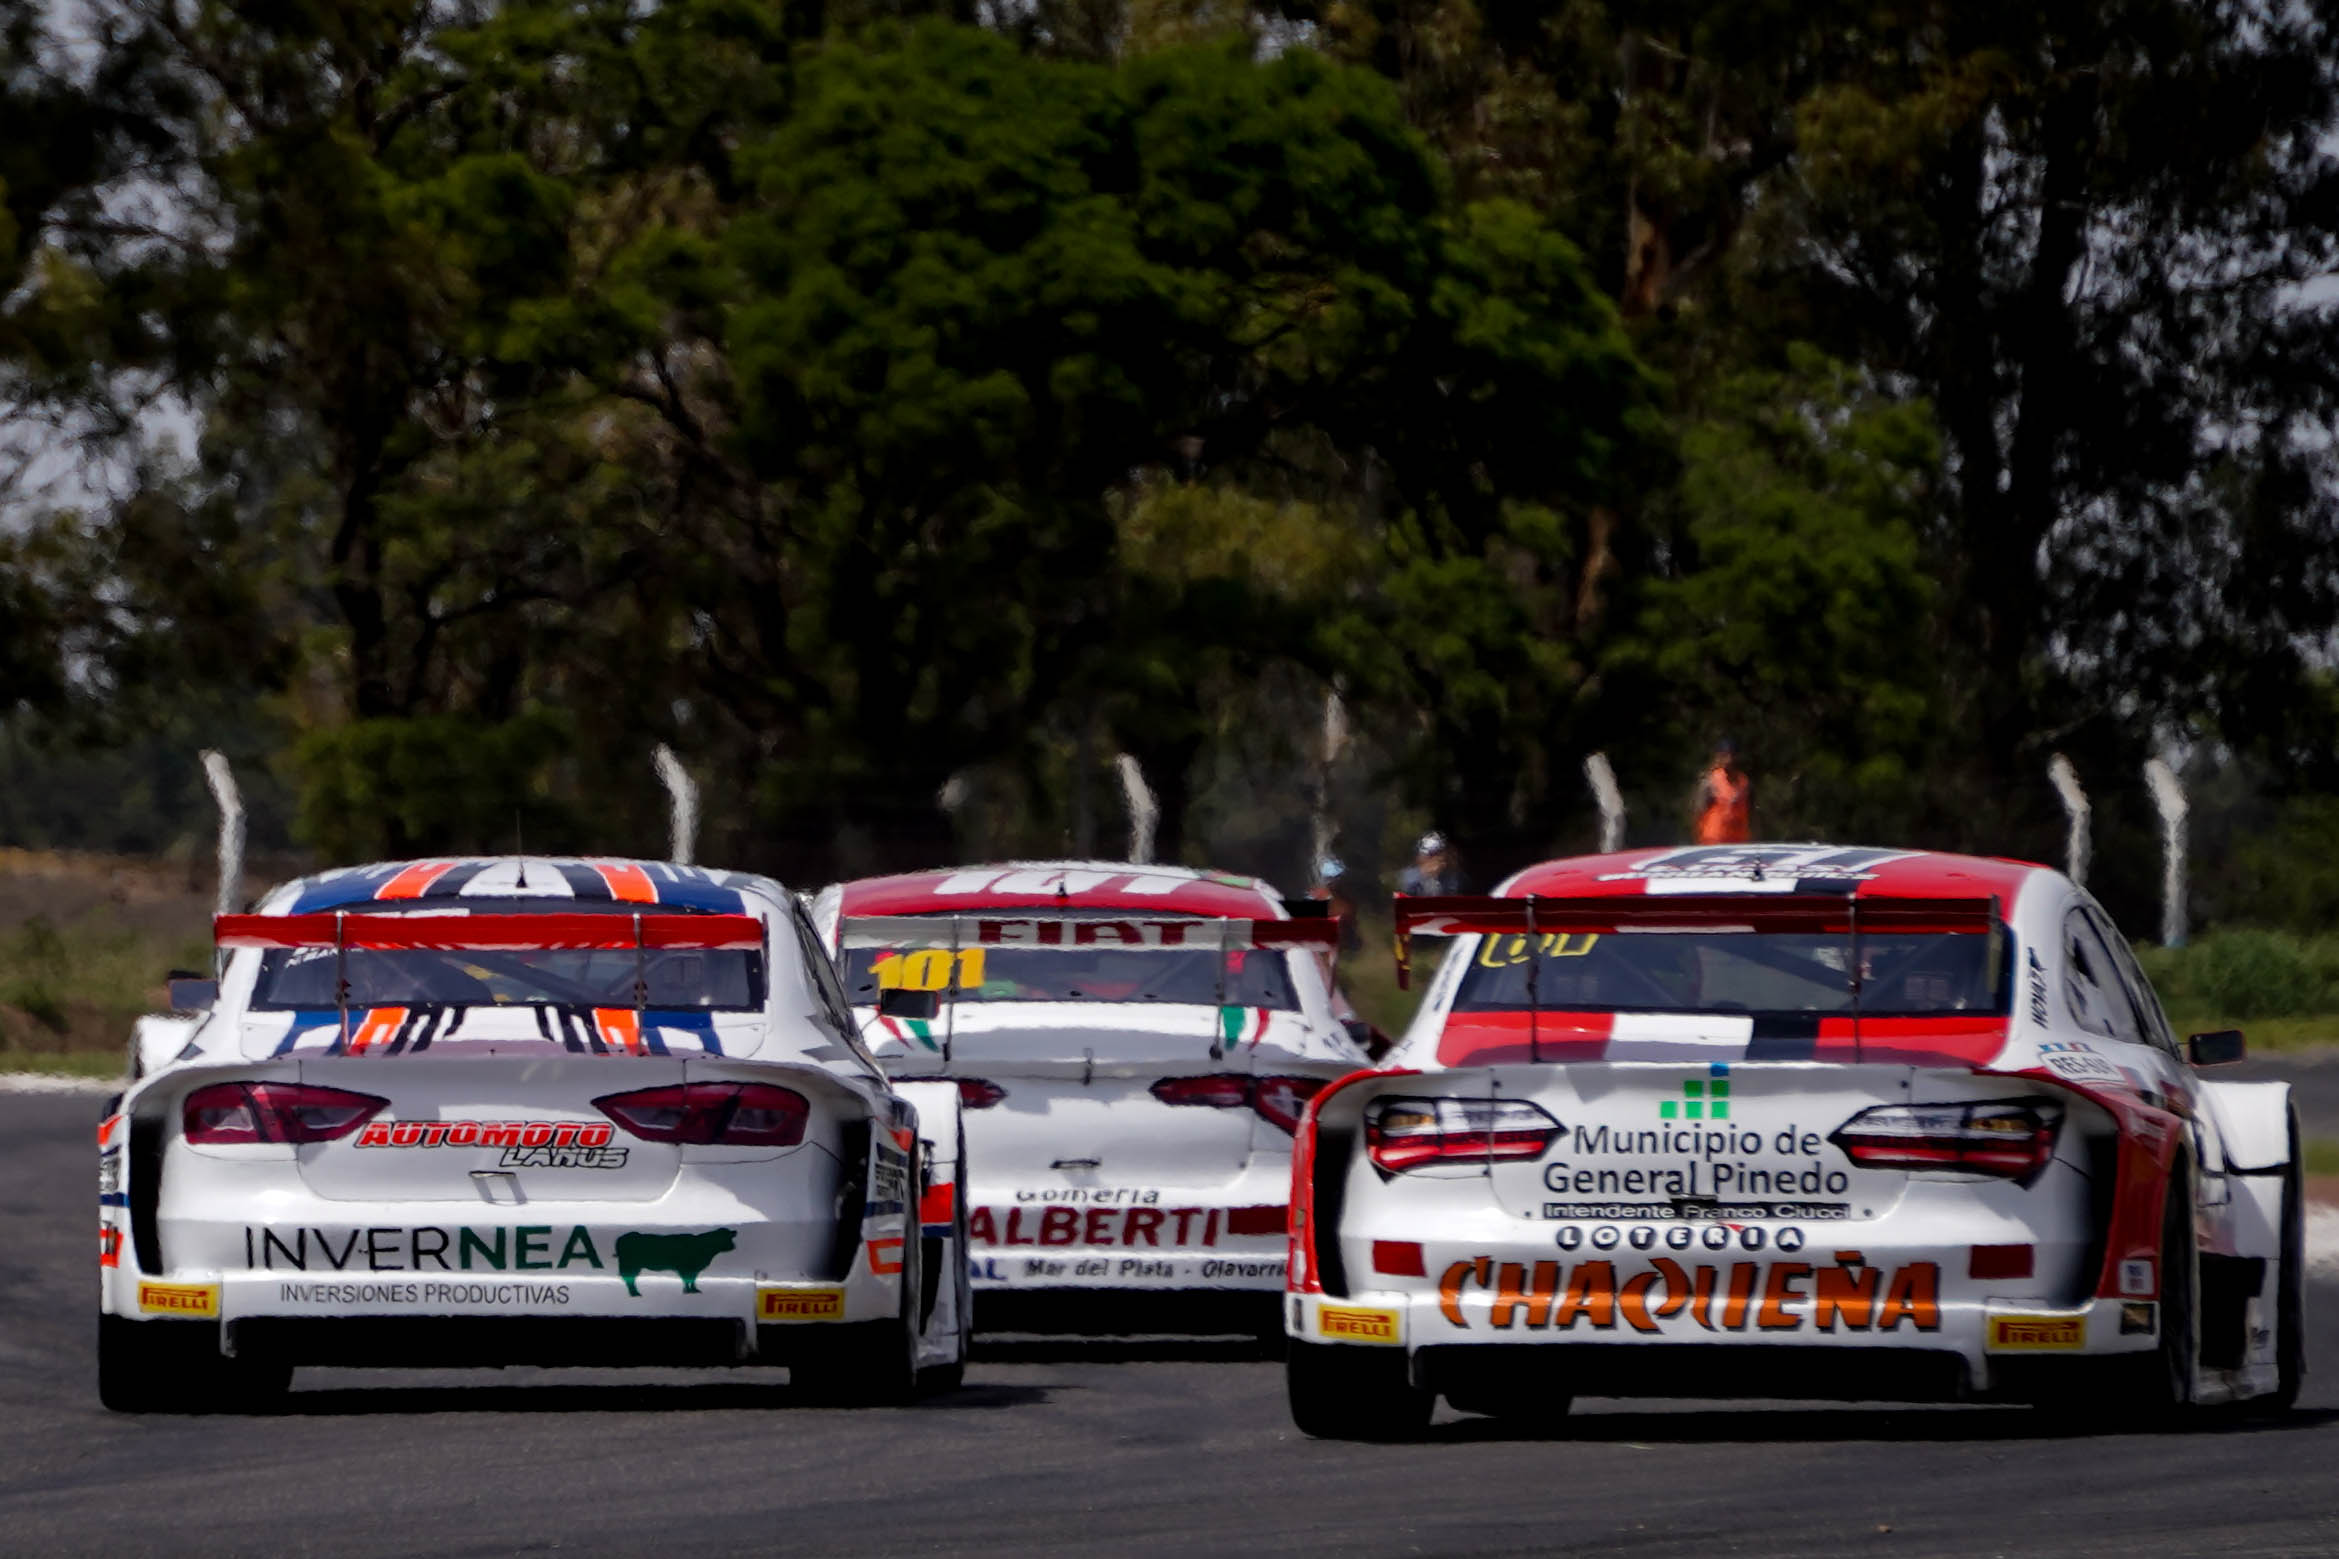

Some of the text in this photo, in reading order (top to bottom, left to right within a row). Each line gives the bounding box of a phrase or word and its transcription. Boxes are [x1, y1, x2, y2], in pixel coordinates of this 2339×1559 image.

[978, 920, 1202, 944] FIAT
[868, 948, 986, 991] 101
[355, 1120, 615, 1148] AUTOMOTO
[1574, 1123, 1822, 1161] Municipio de
[1543, 1161, 1848, 1195] General Pinedo
[1546, 1204, 1675, 1218] Intendente
[1684, 1204, 1767, 1219] Franco
[970, 1206, 1221, 1247] ALBERTI
[245, 1225, 604, 1271] INVERNEA
[1075, 1259, 1107, 1277] del
[1120, 1259, 1174, 1277] Plata
[141, 1287, 209, 1310] PIRELLI
[280, 1284, 570, 1304] INVERSIONES PRODUCTIVAS
[765, 1294, 839, 1314] PIRELLI
[1439, 1250, 1942, 1334] CHAQUEÑA
[1322, 1310, 1391, 1337] PIRELLI
[1997, 1321, 2079, 1344] PIRELLI
